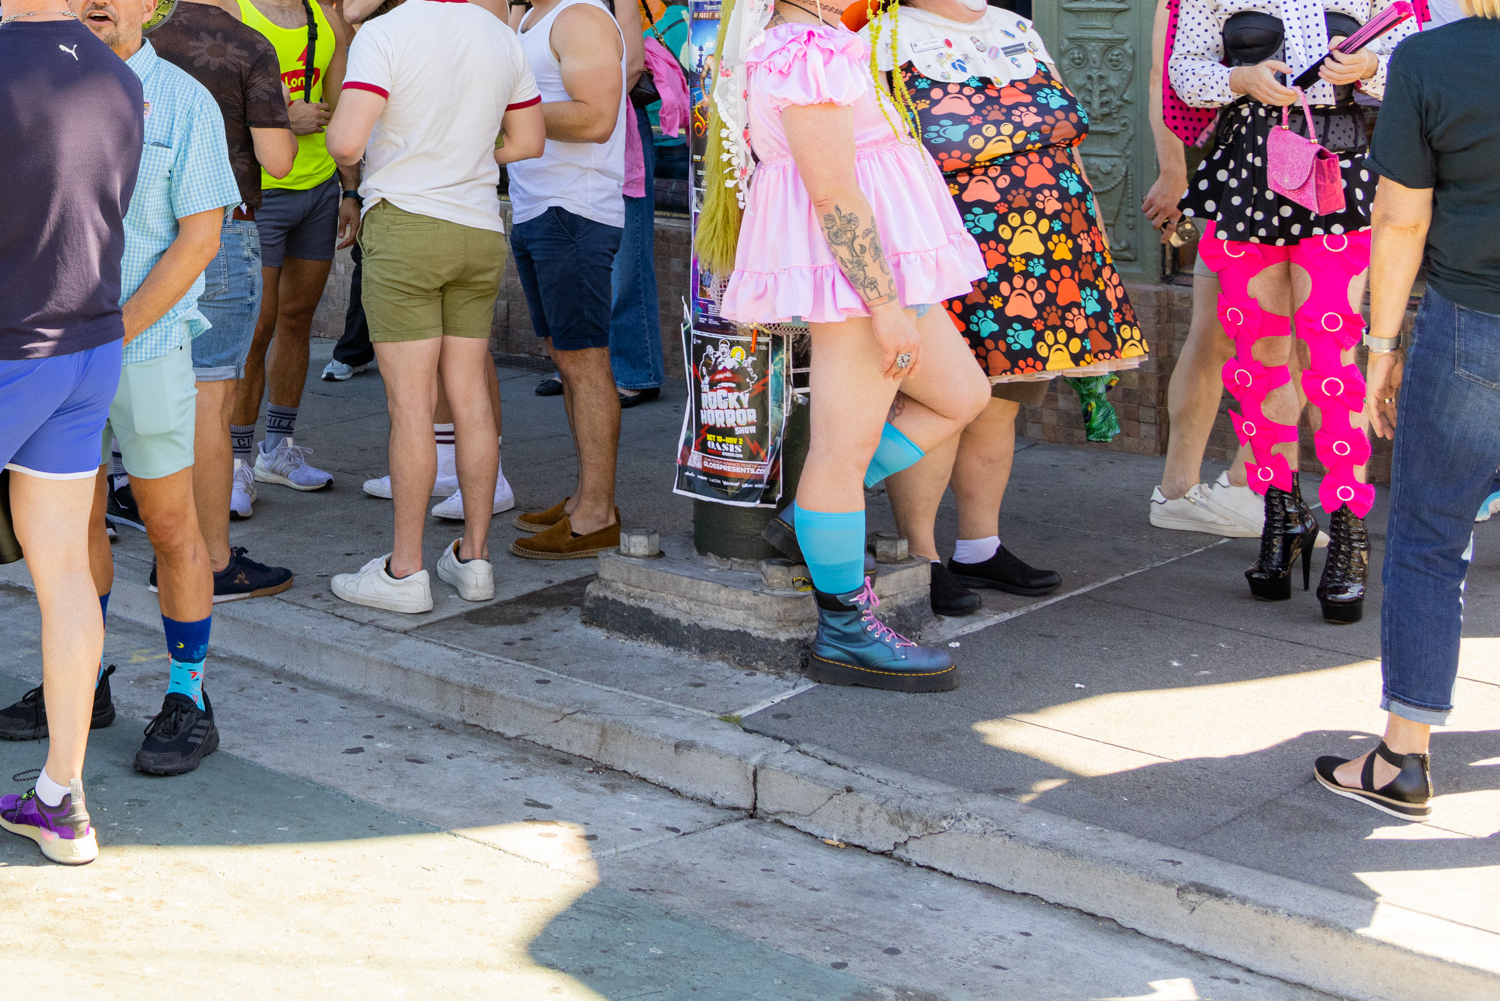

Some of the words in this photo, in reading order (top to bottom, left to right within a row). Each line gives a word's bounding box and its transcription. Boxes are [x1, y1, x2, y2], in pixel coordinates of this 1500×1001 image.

[701, 389, 749, 409] ROCKY
[700, 408, 757, 428] HORROR
[735, 426, 757, 434] SHOW
[707, 441, 742, 453] OASIS
[703, 461, 766, 474] GLOSSPRESENTS.CO
